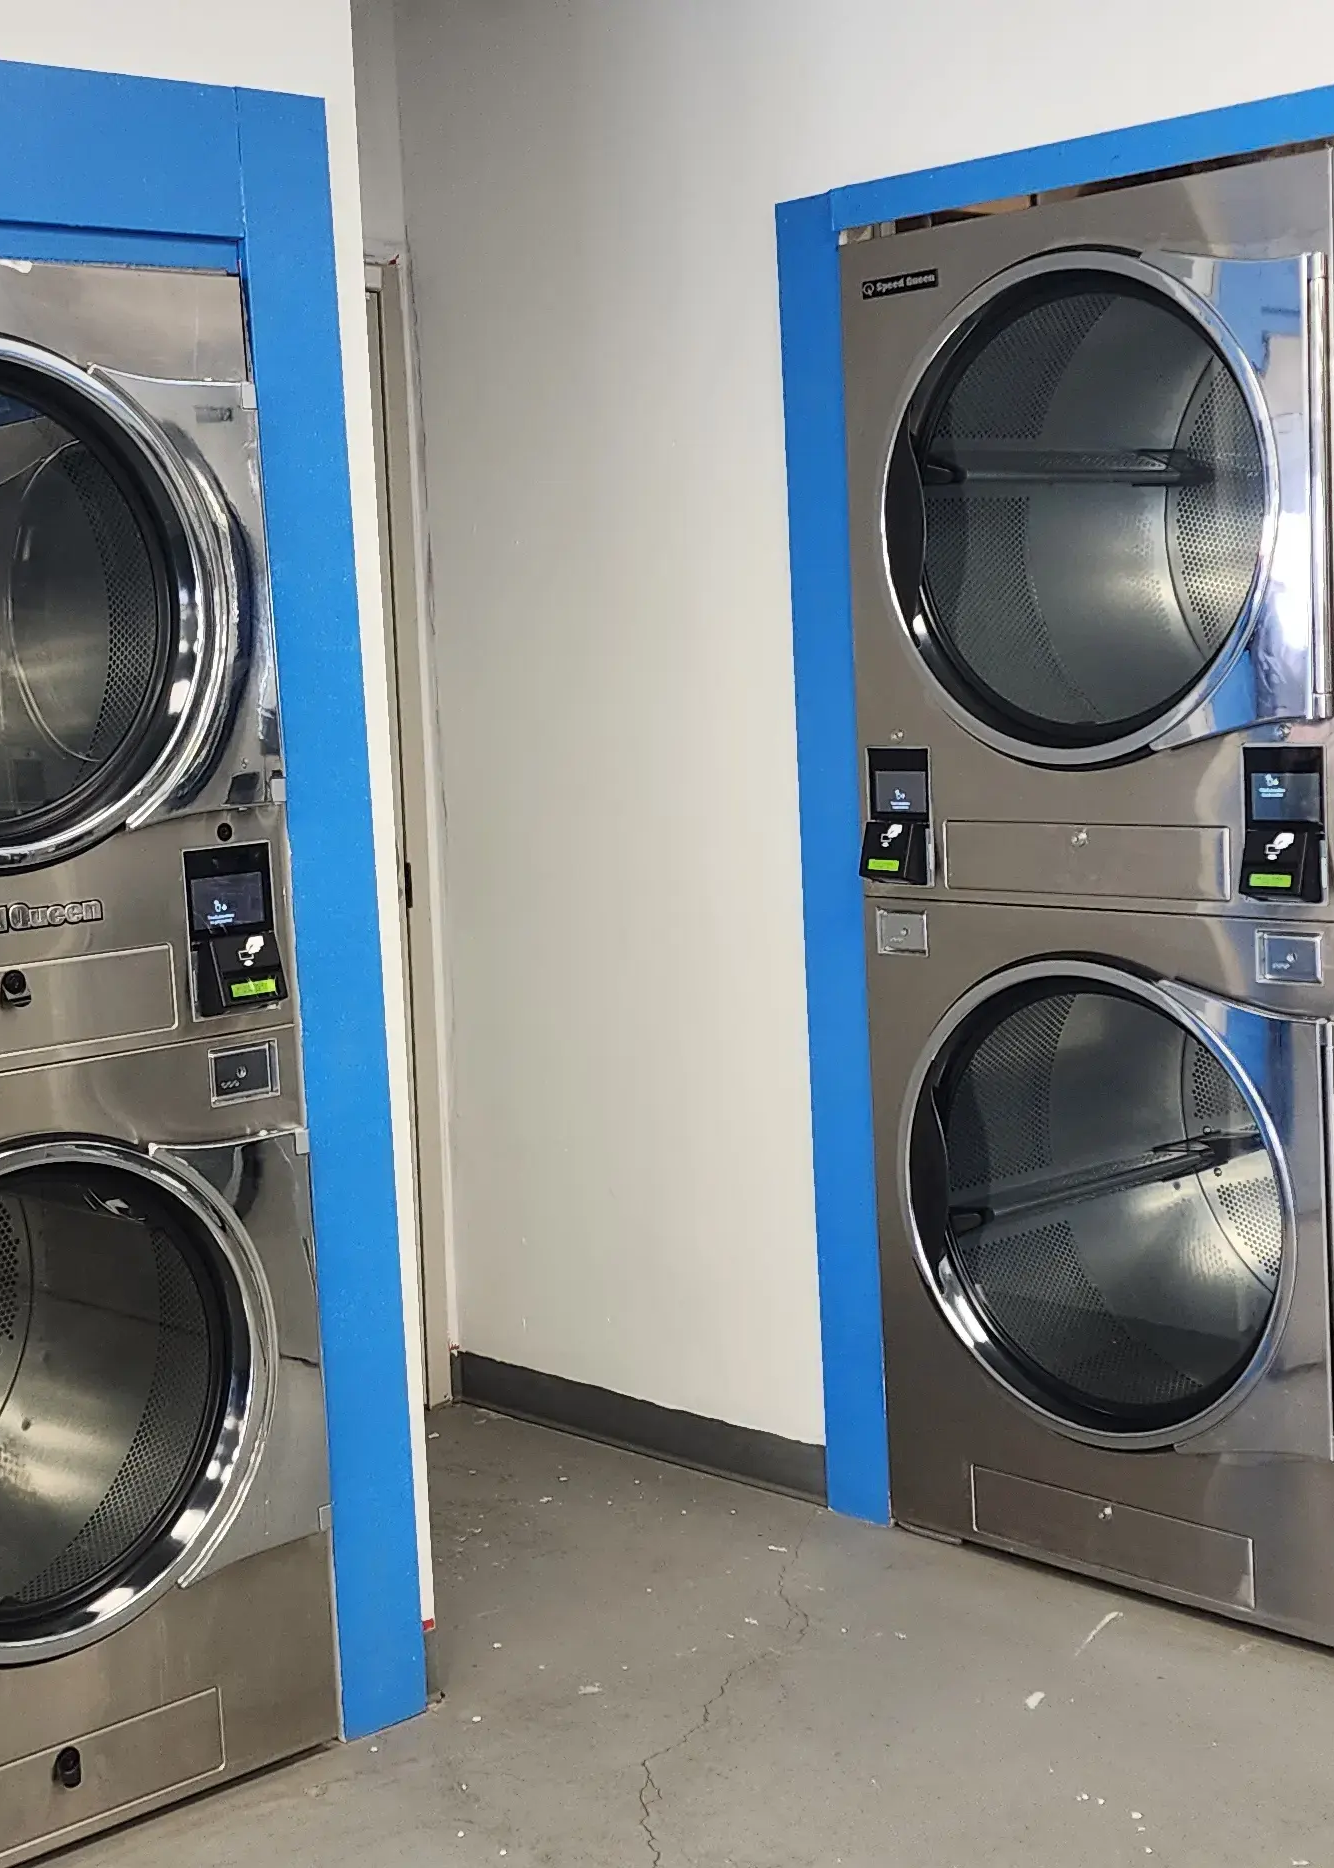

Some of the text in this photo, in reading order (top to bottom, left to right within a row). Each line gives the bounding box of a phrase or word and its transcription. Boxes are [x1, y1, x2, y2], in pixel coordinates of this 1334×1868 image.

[876, 278, 904, 292] Speed
[906, 274, 935, 286] Queen
[7, 899, 104, 932] Queen
